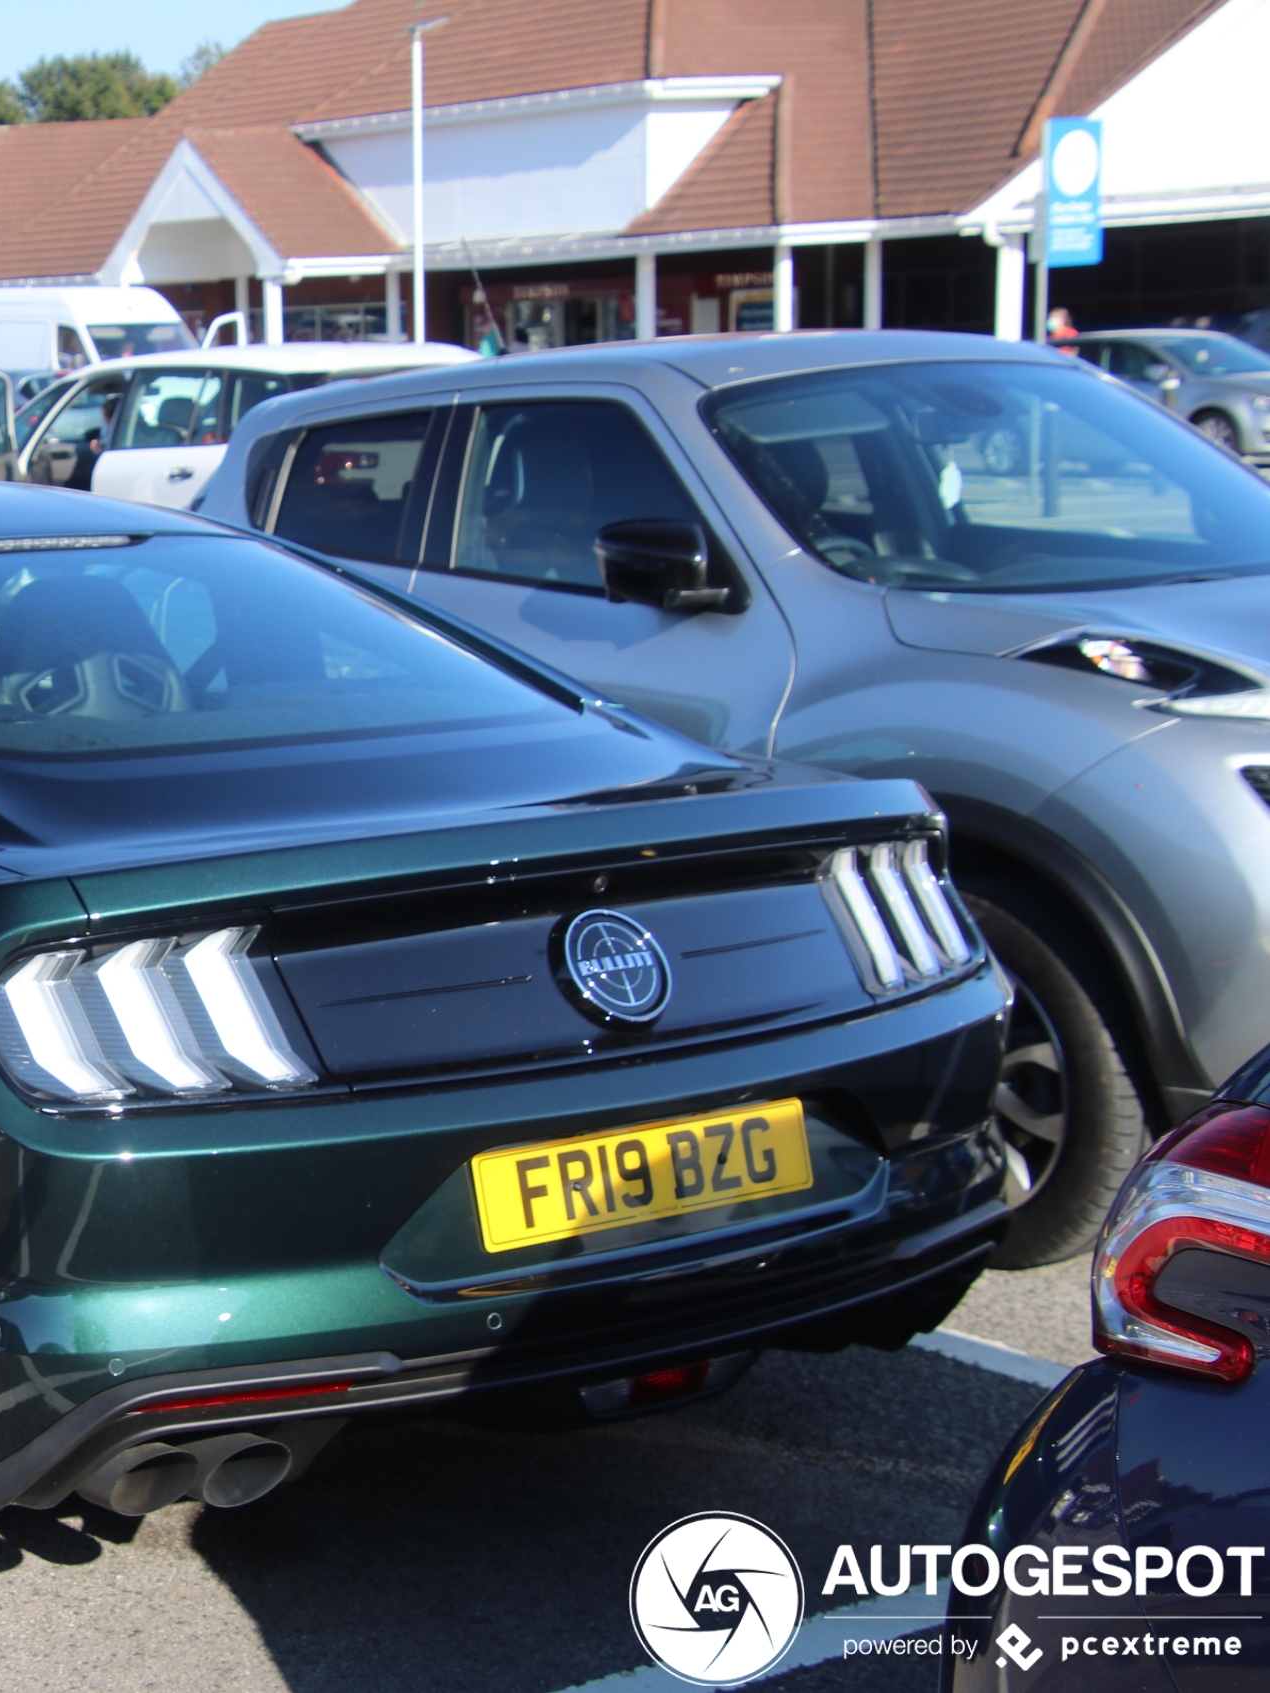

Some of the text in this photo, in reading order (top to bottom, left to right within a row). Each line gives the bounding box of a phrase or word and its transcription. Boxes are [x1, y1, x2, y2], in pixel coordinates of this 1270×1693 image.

[577, 950, 654, 977] BULLITT
[516, 1116, 777, 1229] FR19 BZG
